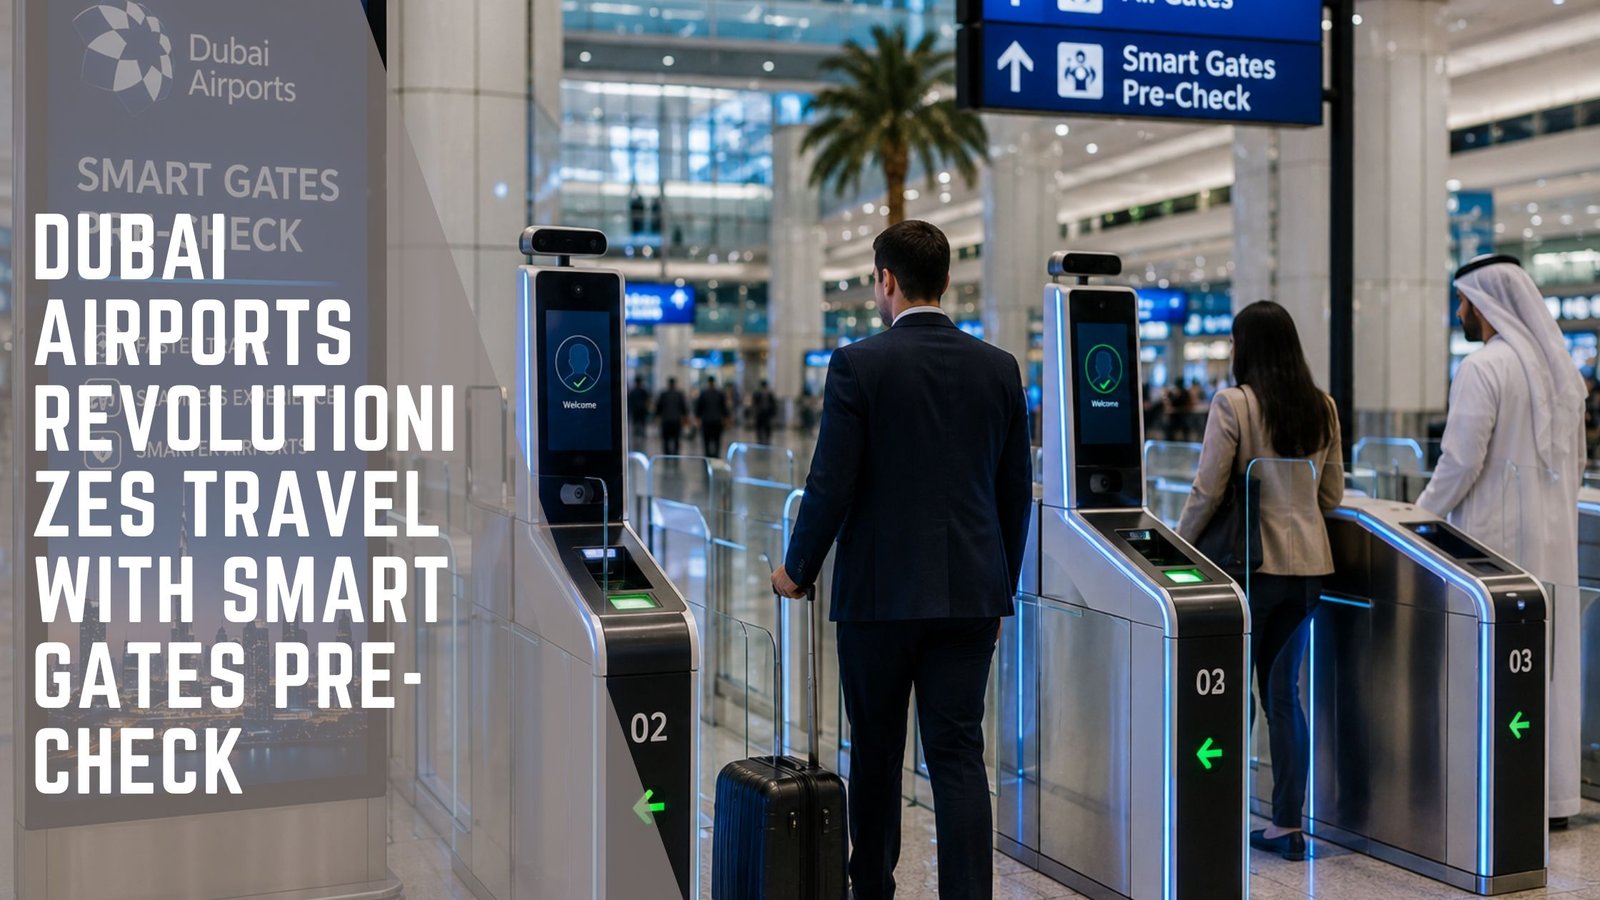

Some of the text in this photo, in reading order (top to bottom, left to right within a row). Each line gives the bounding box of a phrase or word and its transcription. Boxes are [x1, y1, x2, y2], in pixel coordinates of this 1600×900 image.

[189, 33, 269, 67] Dubai
[1123, 45, 1276, 80] Smart Gates
[189, 69, 297, 105] Airports
[1123, 79, 1251, 112] Pre-Check
[77, 156, 340, 202] SMART GATES
[562, 400, 597, 409] Welcome
[1509, 648, 1532, 673] 03
[631, 711, 668, 743] 02
